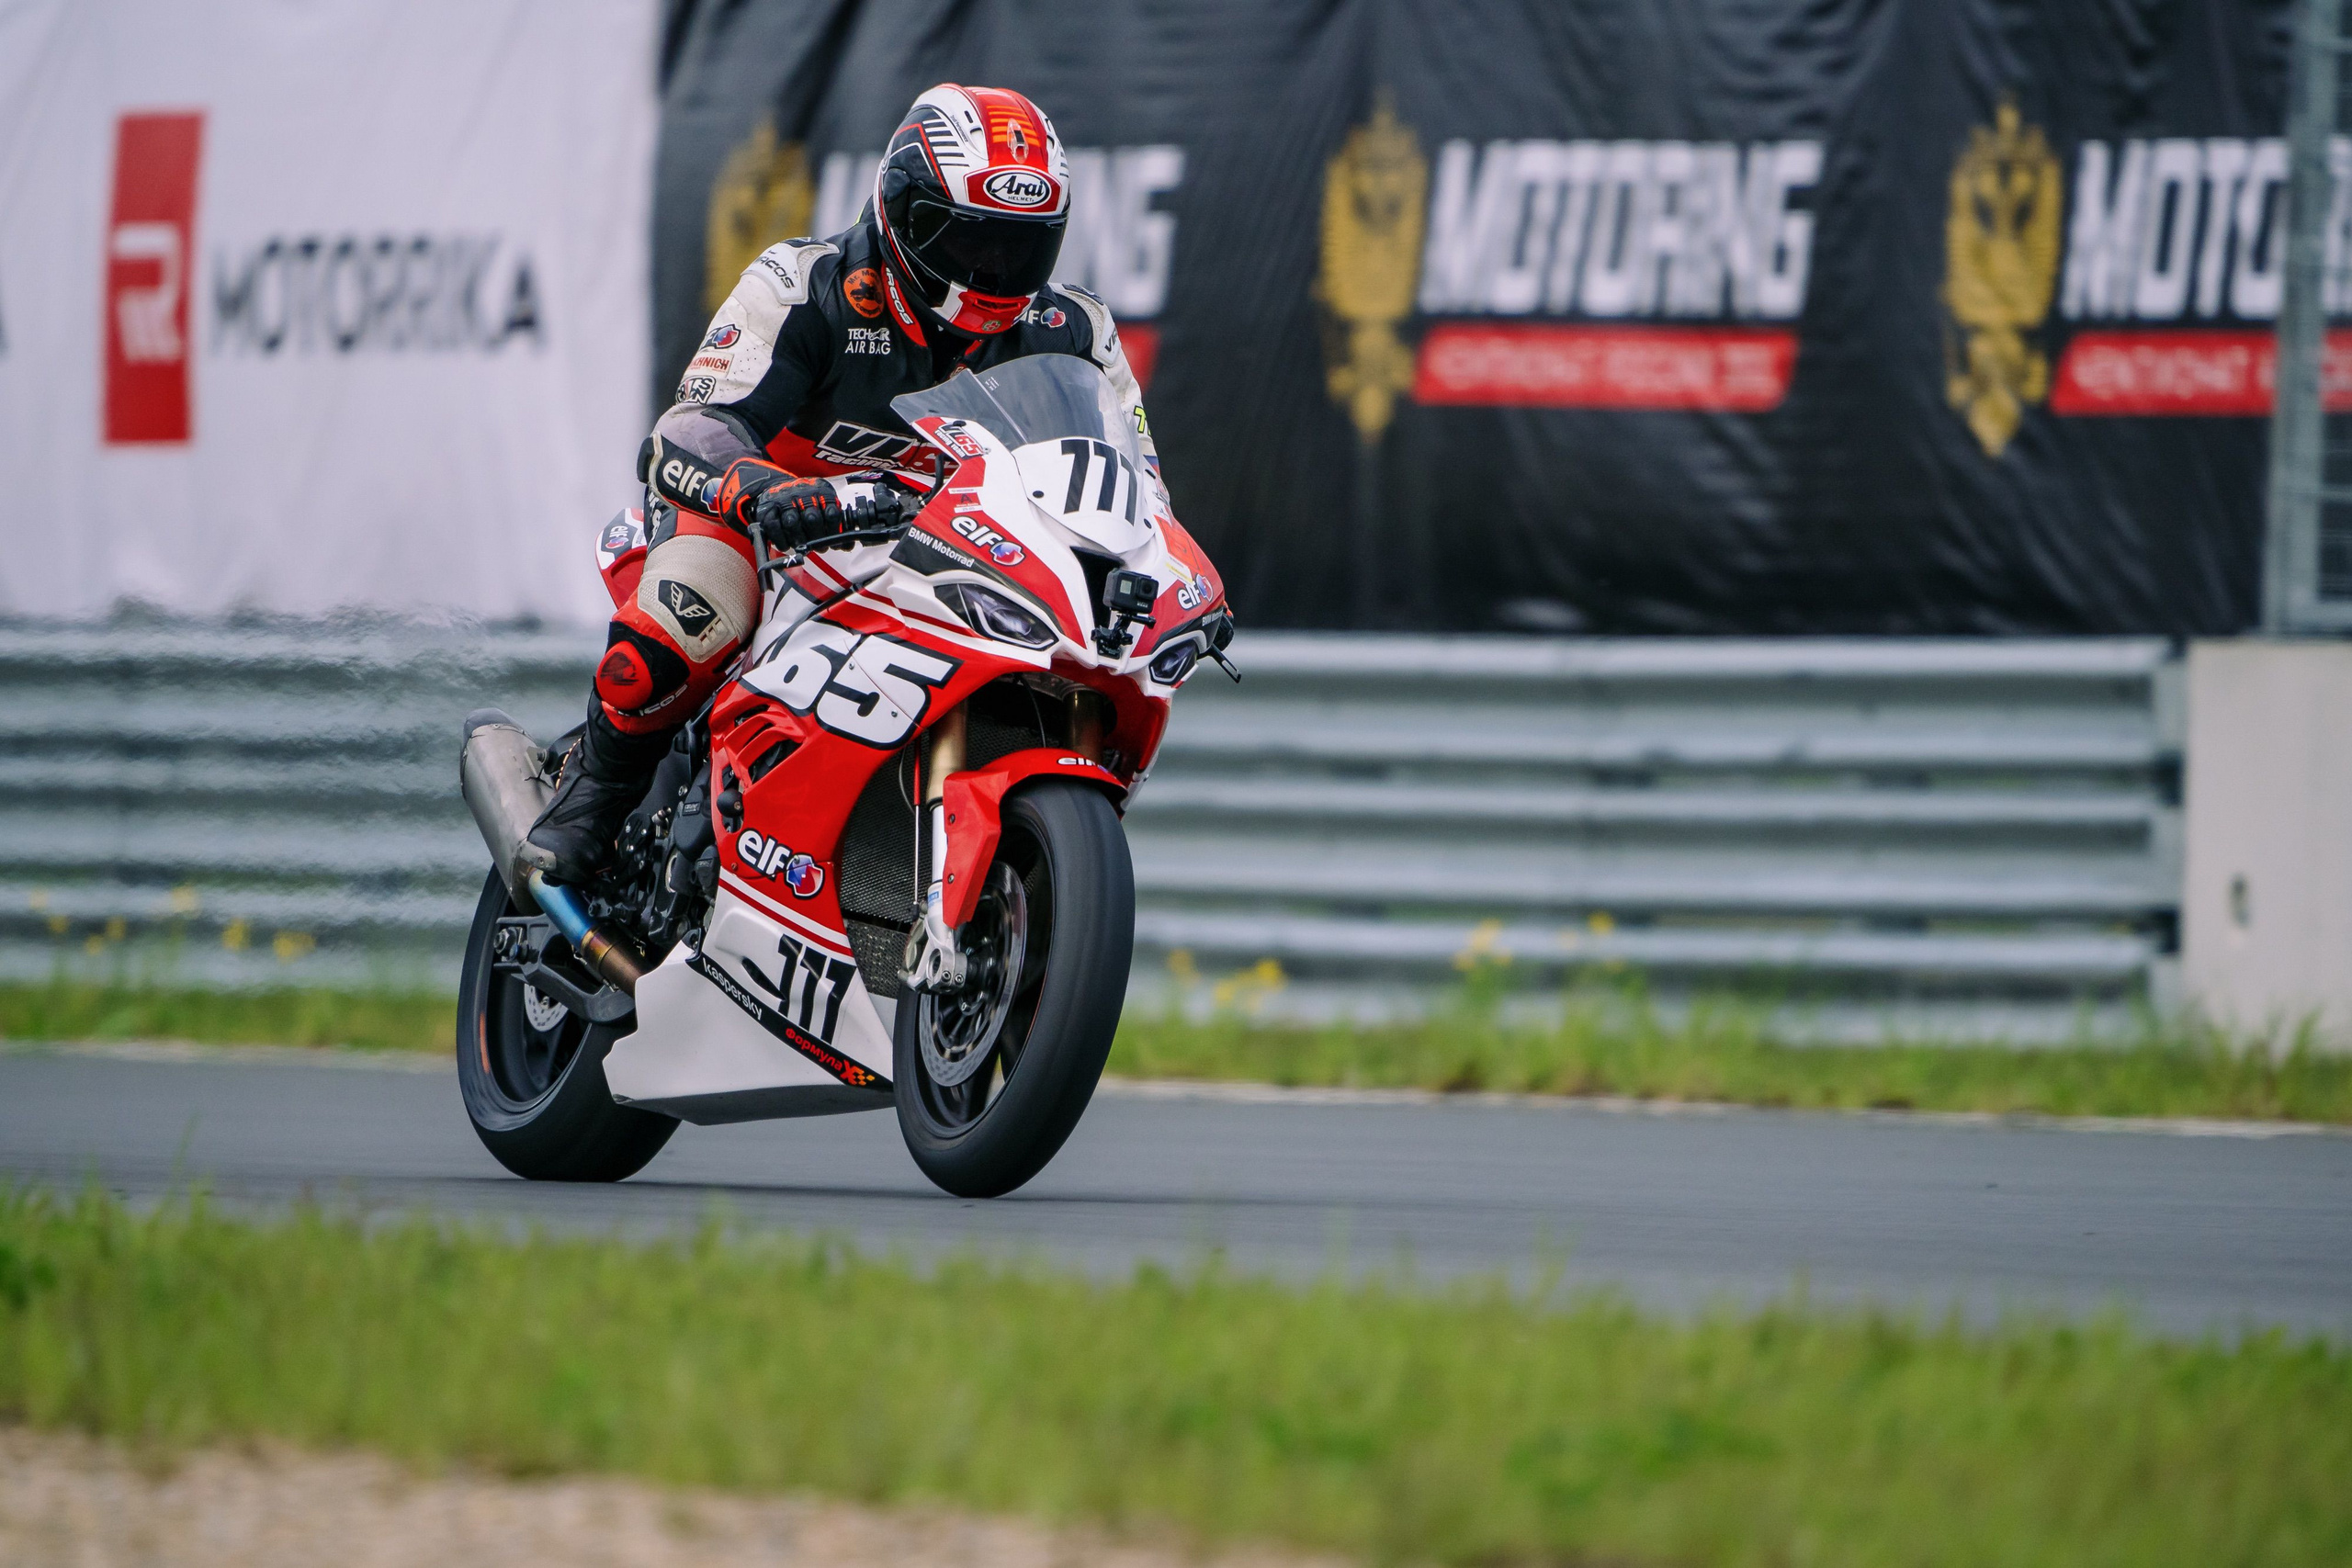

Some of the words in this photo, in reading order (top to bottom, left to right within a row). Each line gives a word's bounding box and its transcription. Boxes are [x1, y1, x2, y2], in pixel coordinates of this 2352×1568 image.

[990, 175, 1045, 197] Arai
[845, 341, 865, 355] AIR
[869, 342, 891, 355] BAG
[662, 458, 707, 498] elf
[1060, 438, 1138, 527] 777
[908, 526, 933, 547] BMW
[932, 539, 975, 569] Motorrad
[950, 515, 1005, 548] elf
[1177, 581, 1202, 611] elf
[737, 829, 792, 881] elf
[702, 957, 763, 1021] kaspersky
[777, 933, 858, 1046] 777
